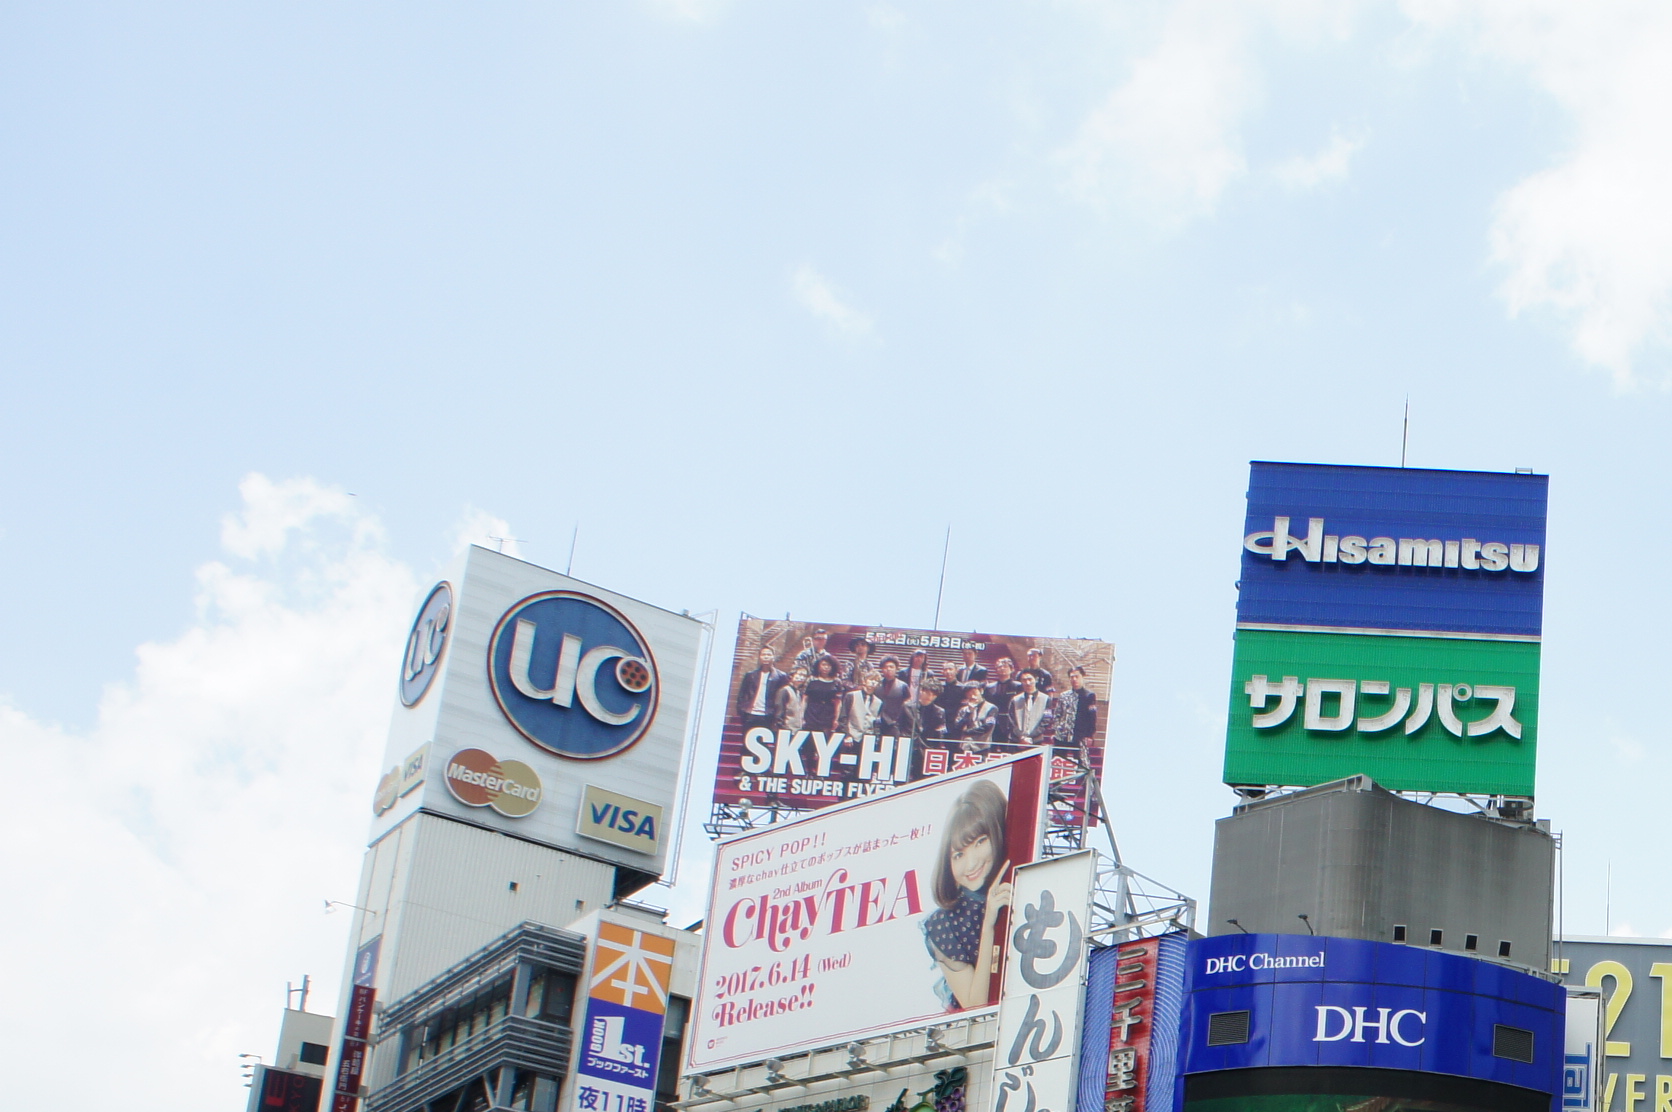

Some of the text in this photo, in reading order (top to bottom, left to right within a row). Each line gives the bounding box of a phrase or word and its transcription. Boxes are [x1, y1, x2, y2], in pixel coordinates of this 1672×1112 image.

[1244, 516, 1540, 572] Hisamitsu
[1245, 675, 1523, 740] サロンパス
[742, 727, 912, 782] SKY-HI
[450, 763, 541, 803] MasterCard
[739, 776, 843, 798] & THE SUPER
[591, 801, 656, 841] VISA
[731, 832, 827, 871] SPICY POP!!
[773, 878, 822, 900] 2nd Album
[715, 951, 852, 1000] 2017.6.14 (Wed)
[1205, 952, 1325, 975] DHC Channel
[712, 983, 816, 1028] Release!!
[1313, 1004, 1427, 1047] DHC
[593, 1019, 606, 1054] BOOK
[587, 1056, 649, 1079] ブックファースト
